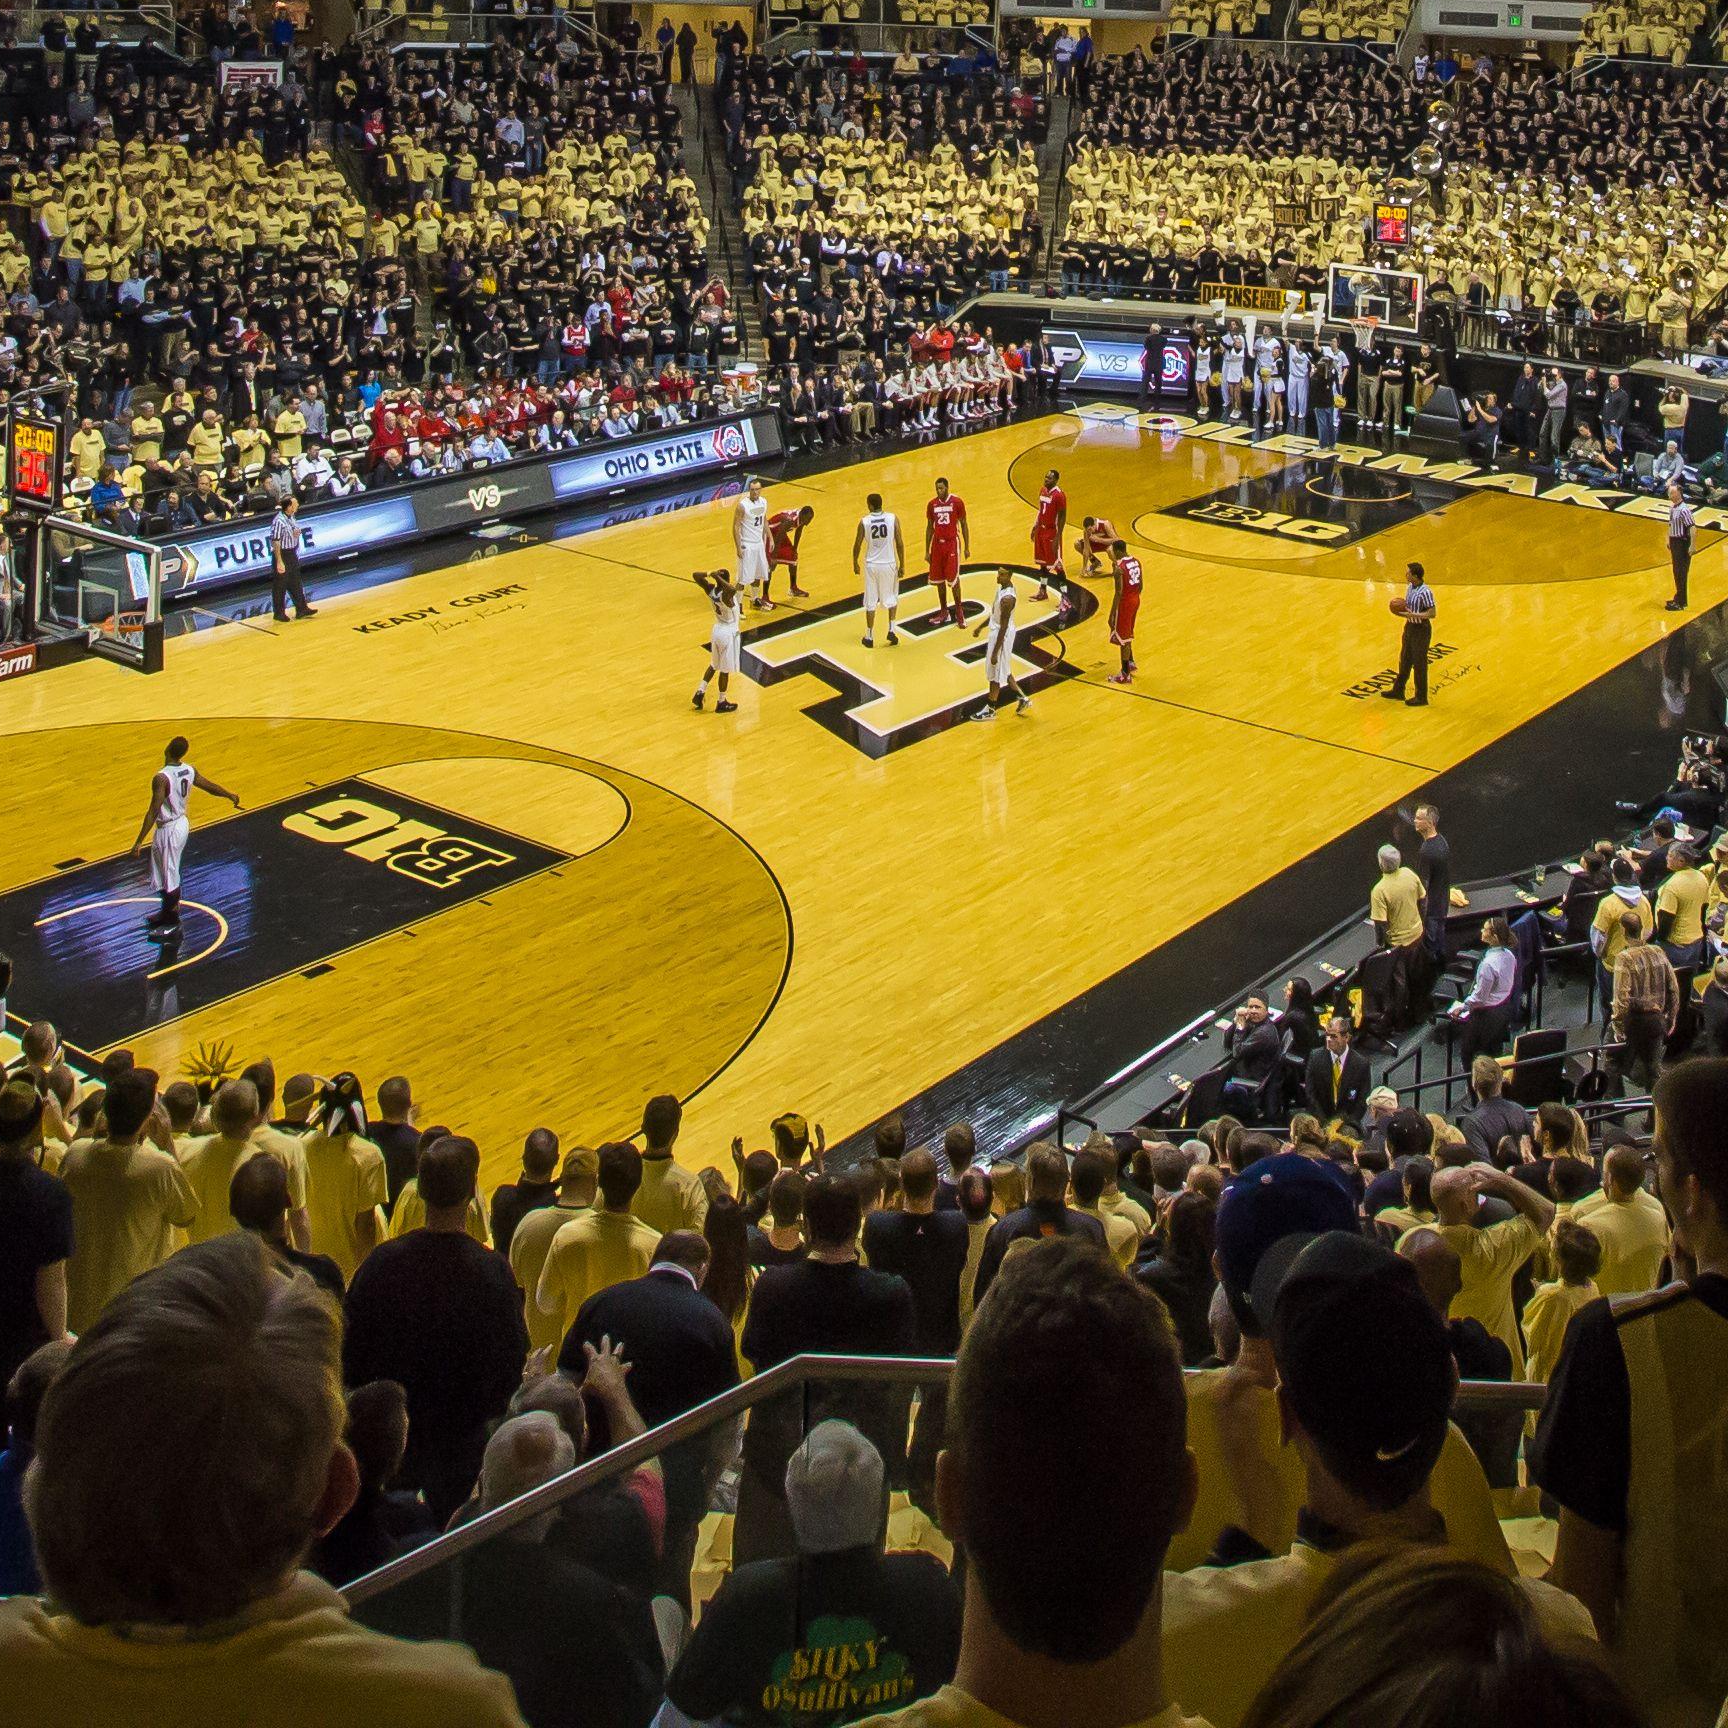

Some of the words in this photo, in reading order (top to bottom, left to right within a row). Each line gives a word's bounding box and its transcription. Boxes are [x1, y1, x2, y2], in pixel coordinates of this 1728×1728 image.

[1377, 205, 1408, 220] 20:00
[1203, 284, 1262, 309] DEFENSE
[1098, 354, 1128, 372] VS
[14, 424, 54, 453] 20:00
[604, 450, 649, 478] OHIO
[656, 440, 704, 468] STATE
[468, 485, 501, 511] VS
[937, 513, 951, 525] 23
[871, 524, 888, 539] 20
[214, 526, 315, 569] PURE
[1128, 568, 1141, 585] 32
[352, 606, 441, 634] KEADY
[449, 583, 528, 608] COURT
[180, 778, 189, 798] 0
